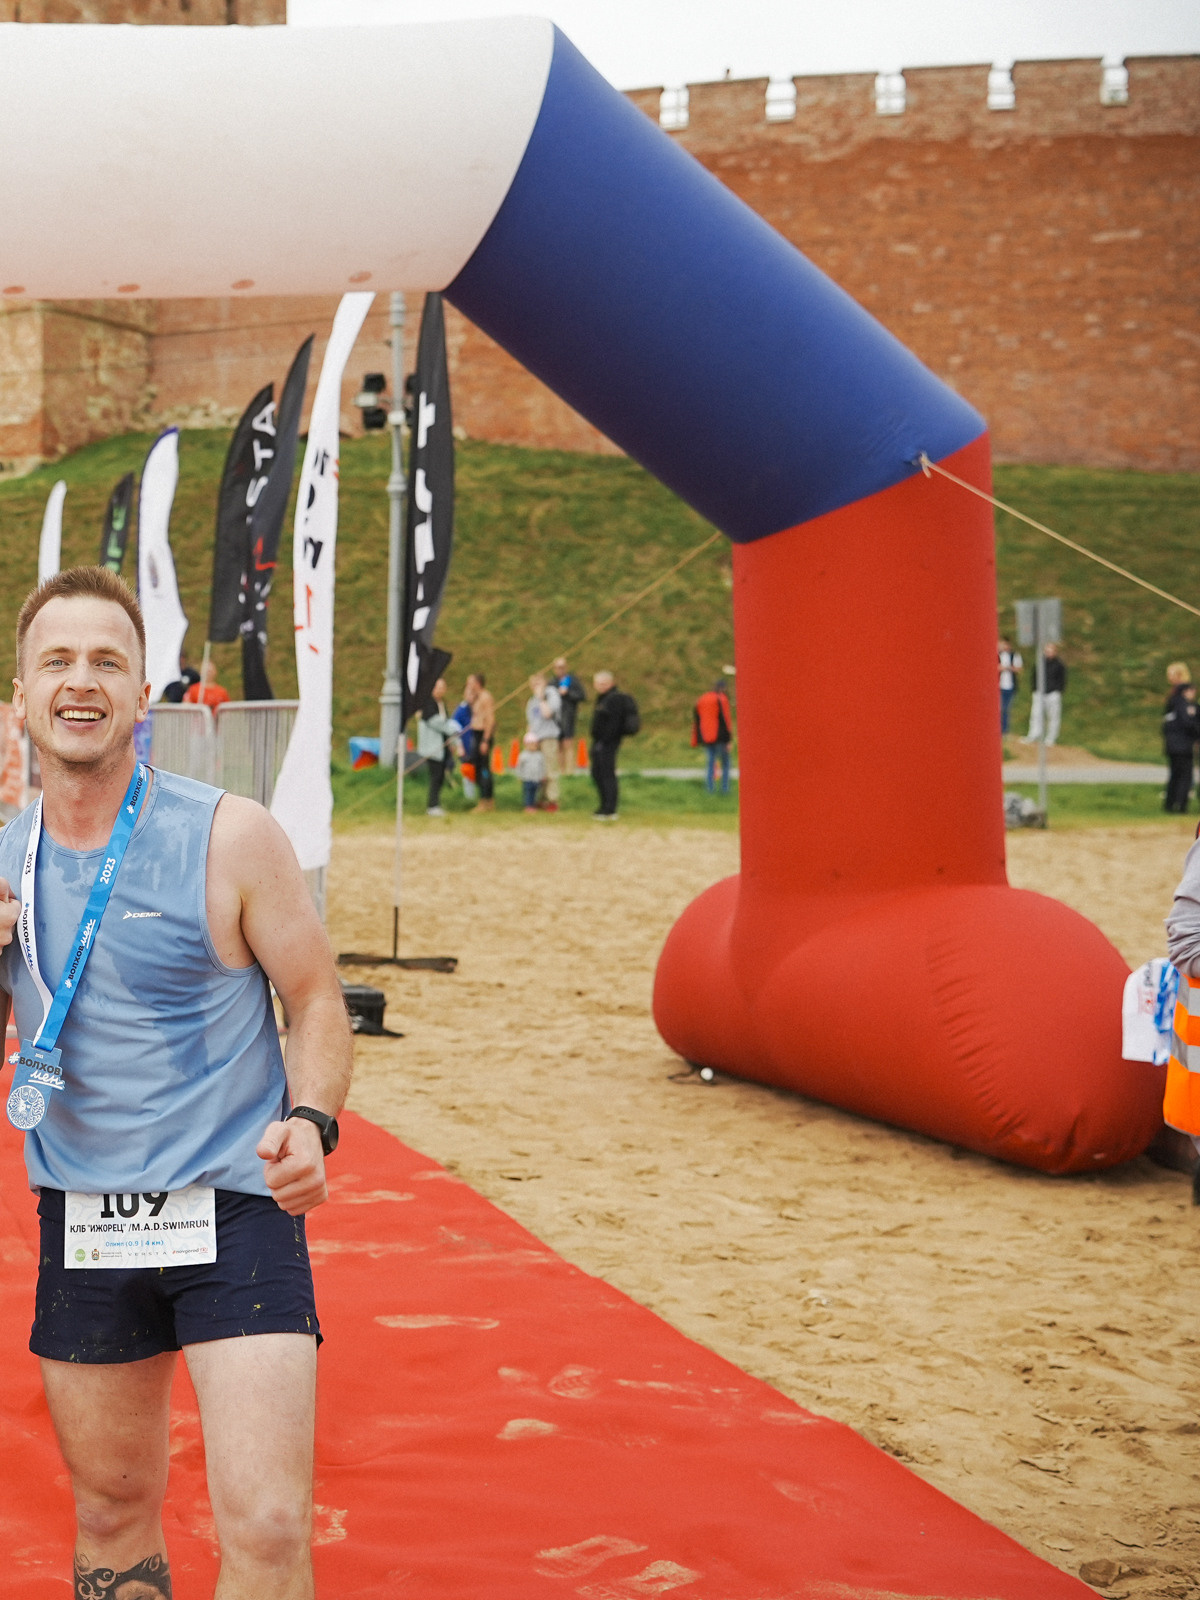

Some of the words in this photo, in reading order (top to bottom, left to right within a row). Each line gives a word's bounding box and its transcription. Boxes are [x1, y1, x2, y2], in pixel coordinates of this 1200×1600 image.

[100, 857, 116, 884] 2023
[132, 911, 162, 919] DEMIX
[8, 1052, 61, 1076] #ВОЛХОВ
[100, 1192, 169, 1219] 109
[69, 1224, 86, 1233] КЛБ
[87, 1223, 127, 1233] "ИЖОРЕЦ"
